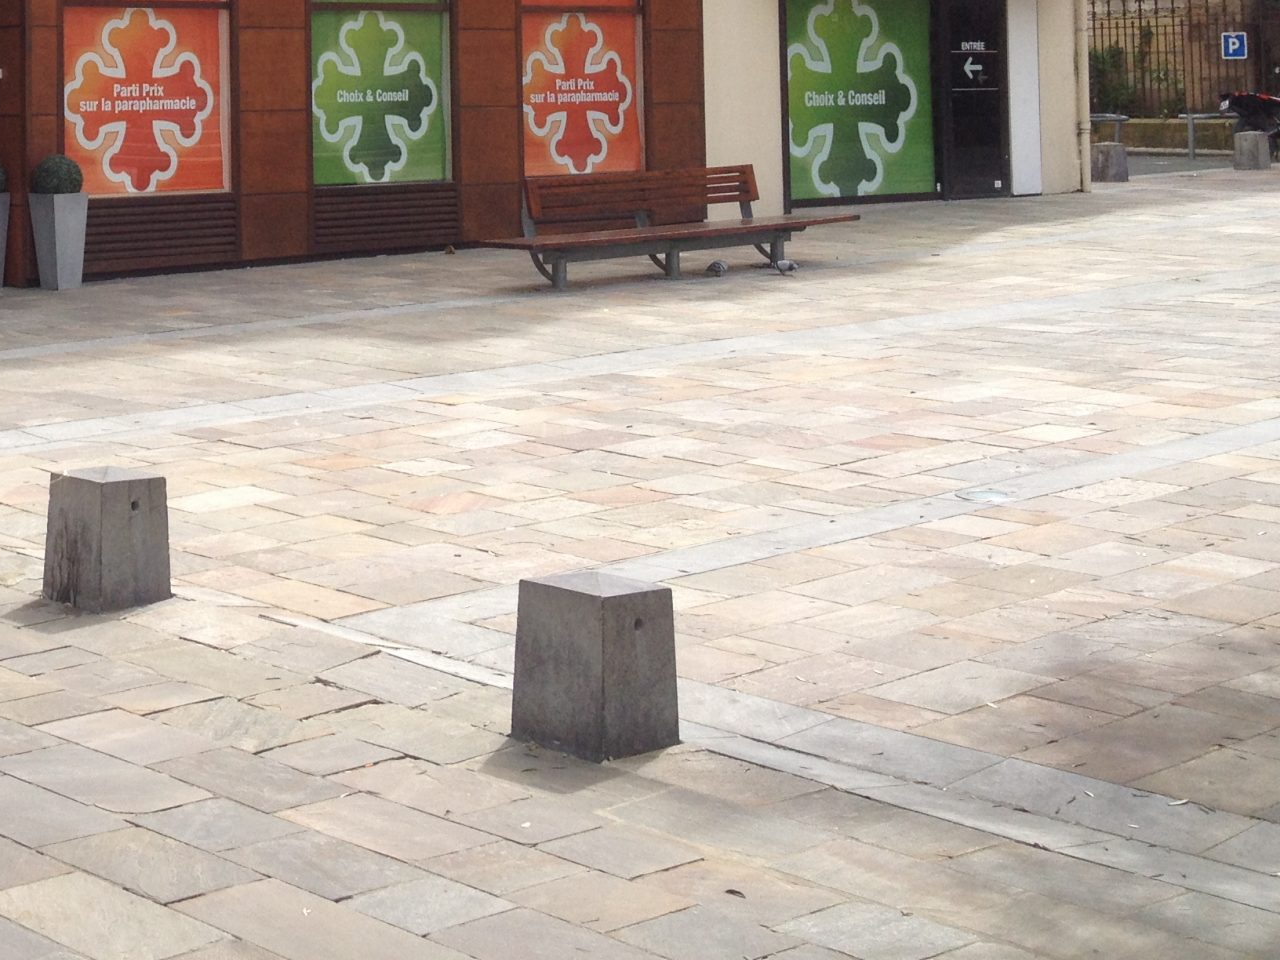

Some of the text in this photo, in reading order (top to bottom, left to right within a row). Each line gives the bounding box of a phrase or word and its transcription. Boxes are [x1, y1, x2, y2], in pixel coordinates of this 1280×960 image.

[1228, 37, 1240, 54] P
[113, 82, 165, 98] Parti Prix
[555, 77, 595, 90] Parti Prix
[336, 88, 409, 103] Choix & Conseil
[530, 89, 619, 105] sur la parapharmacie
[804, 89, 886, 107] Choix & Conseil
[79, 96, 196, 114] sur la parapharmacie
